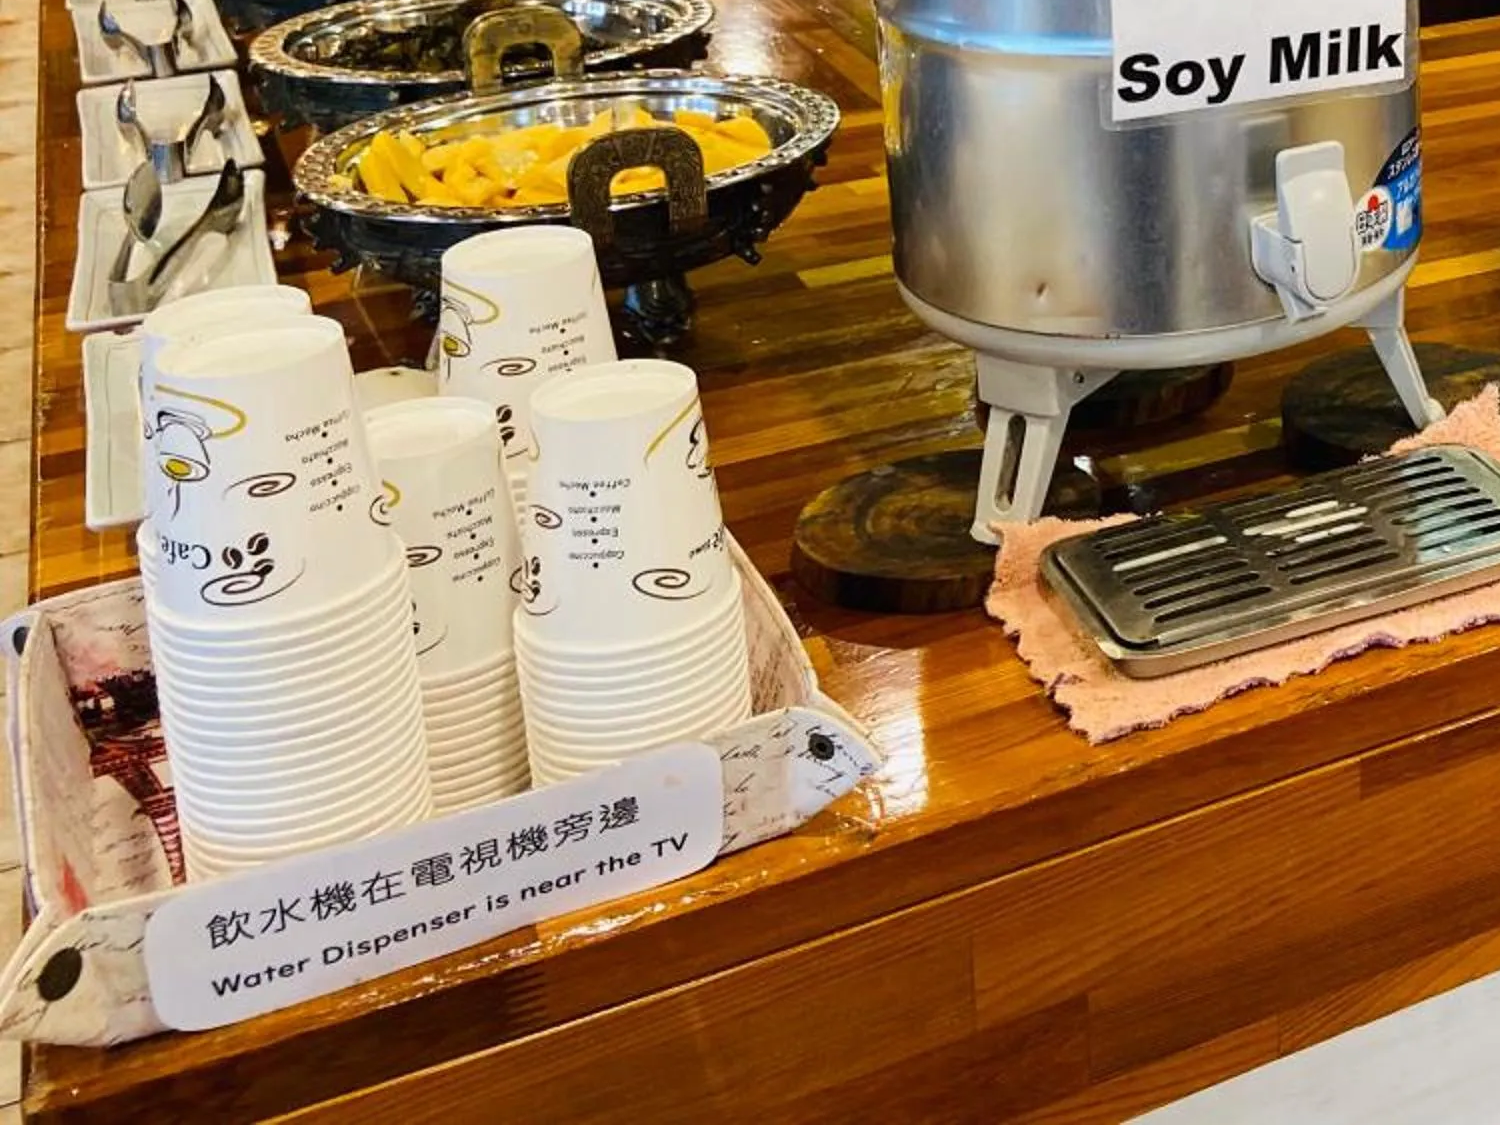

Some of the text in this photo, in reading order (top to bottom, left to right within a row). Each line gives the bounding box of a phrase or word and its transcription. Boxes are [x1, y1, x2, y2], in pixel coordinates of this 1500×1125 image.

[1116, 23, 1404, 105] Soy Milk
[205, 795, 640, 950] 飲水機在電視機旁邊
[211, 831, 689, 997] Water Dispenser is near the TV
